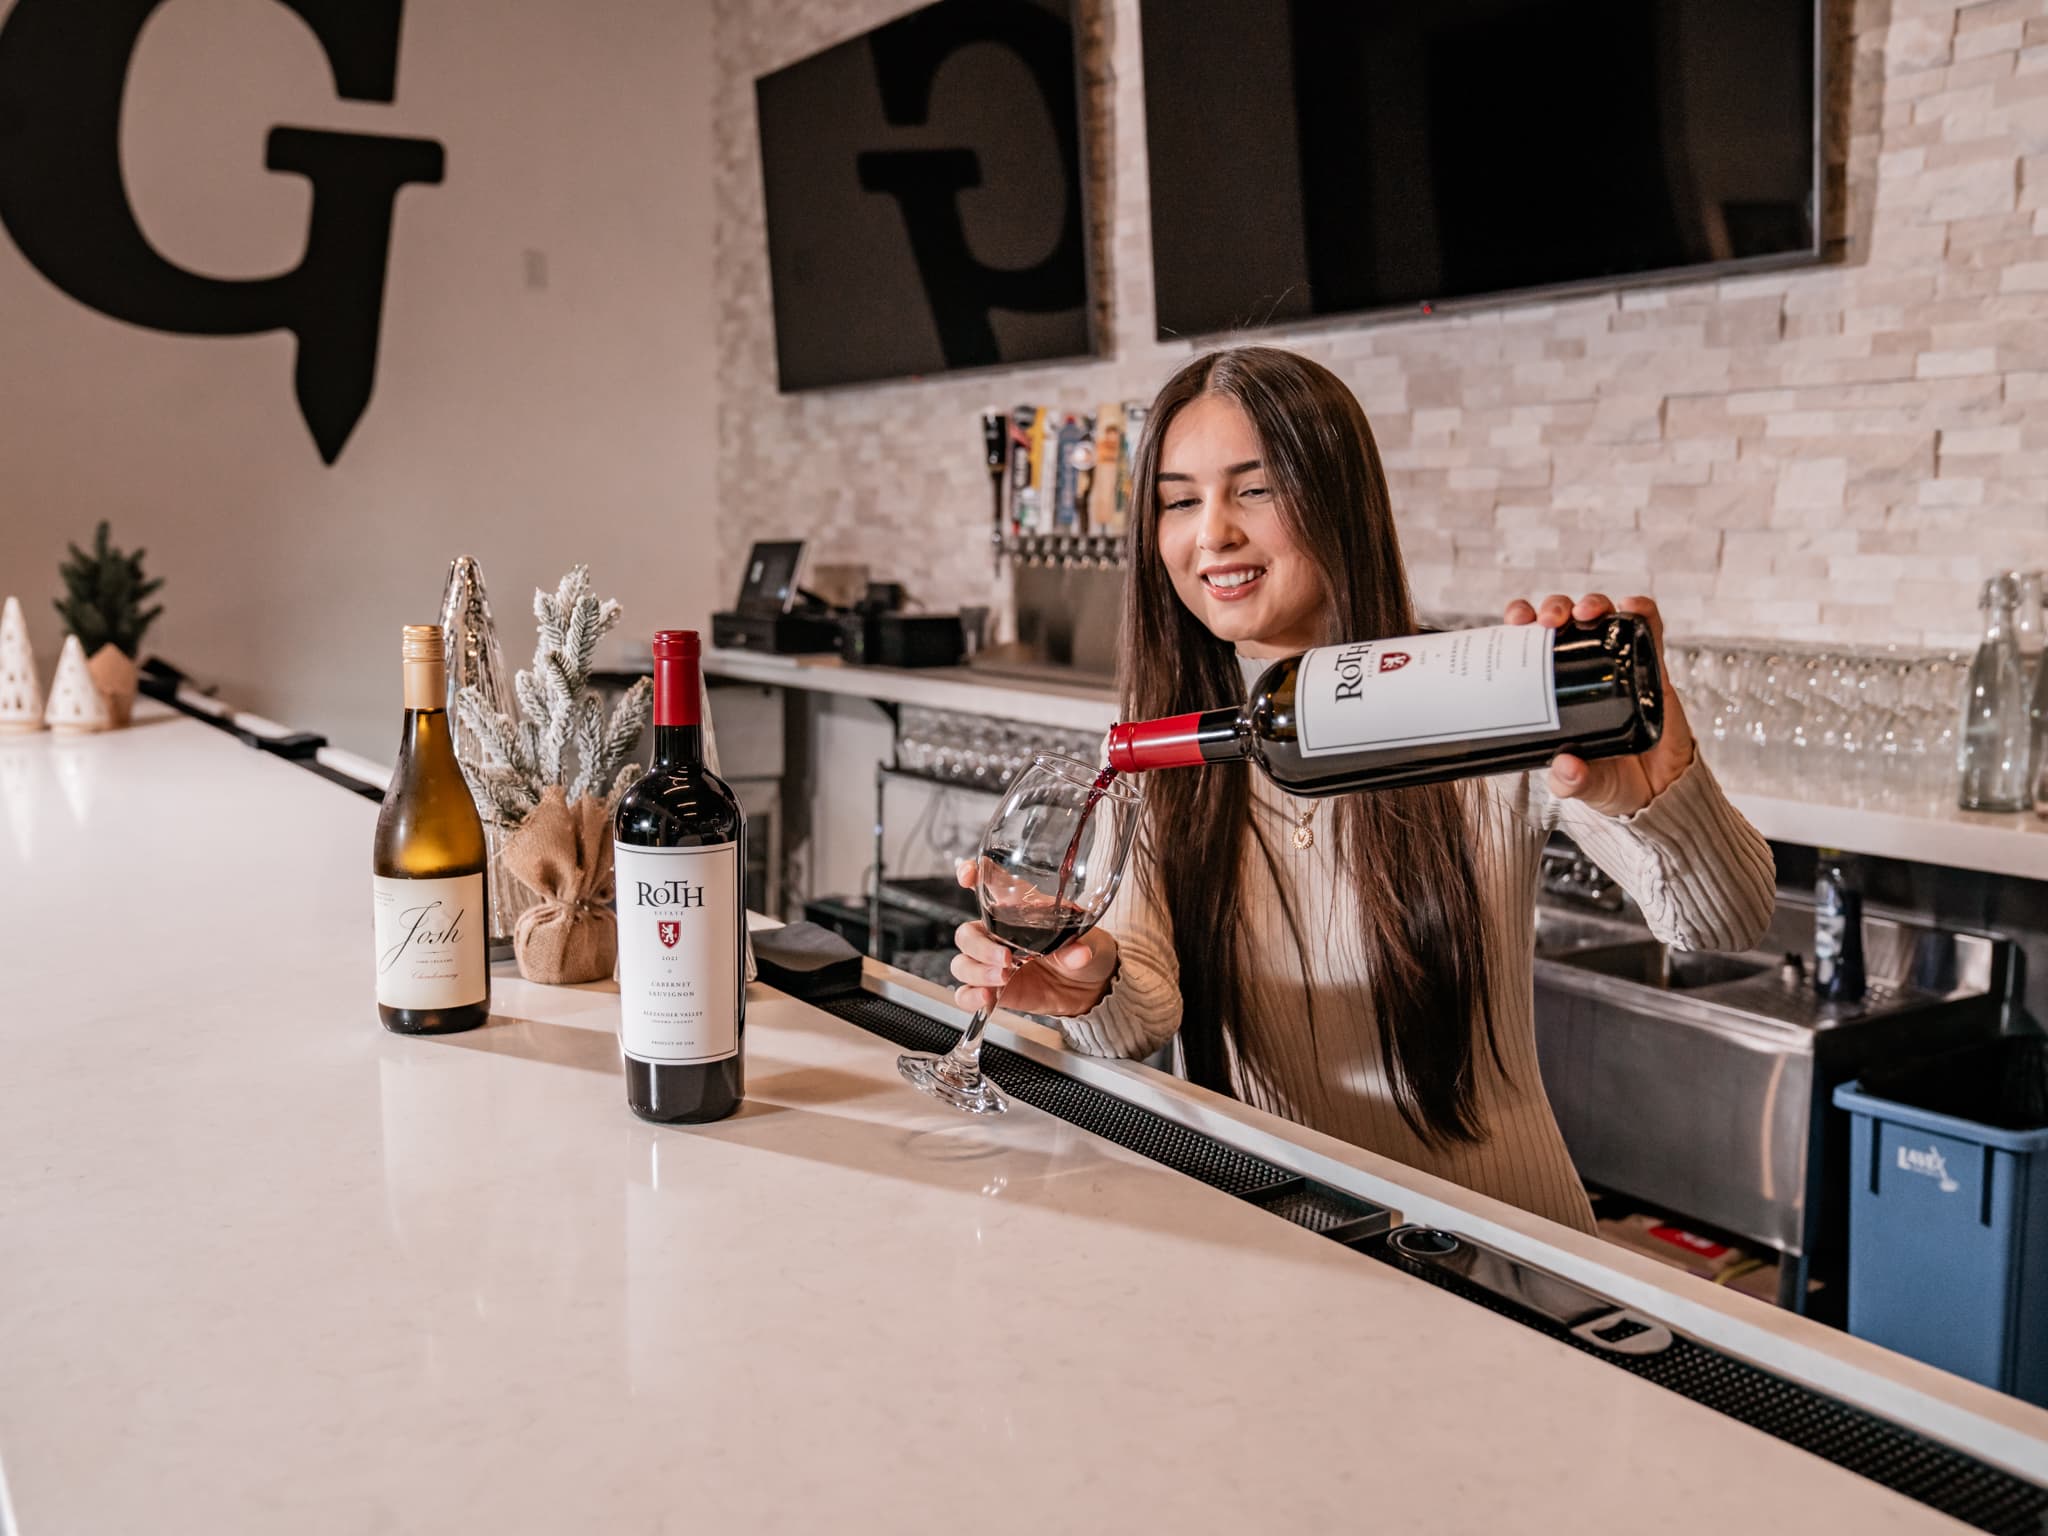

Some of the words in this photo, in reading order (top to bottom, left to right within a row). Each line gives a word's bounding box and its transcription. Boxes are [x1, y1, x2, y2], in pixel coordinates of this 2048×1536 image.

[0, 0, 446, 465] G
[636, 880, 705, 908] ROTH
[379, 901, 464, 975] Josh
[648, 990, 695, 998] SAUVIGNON
